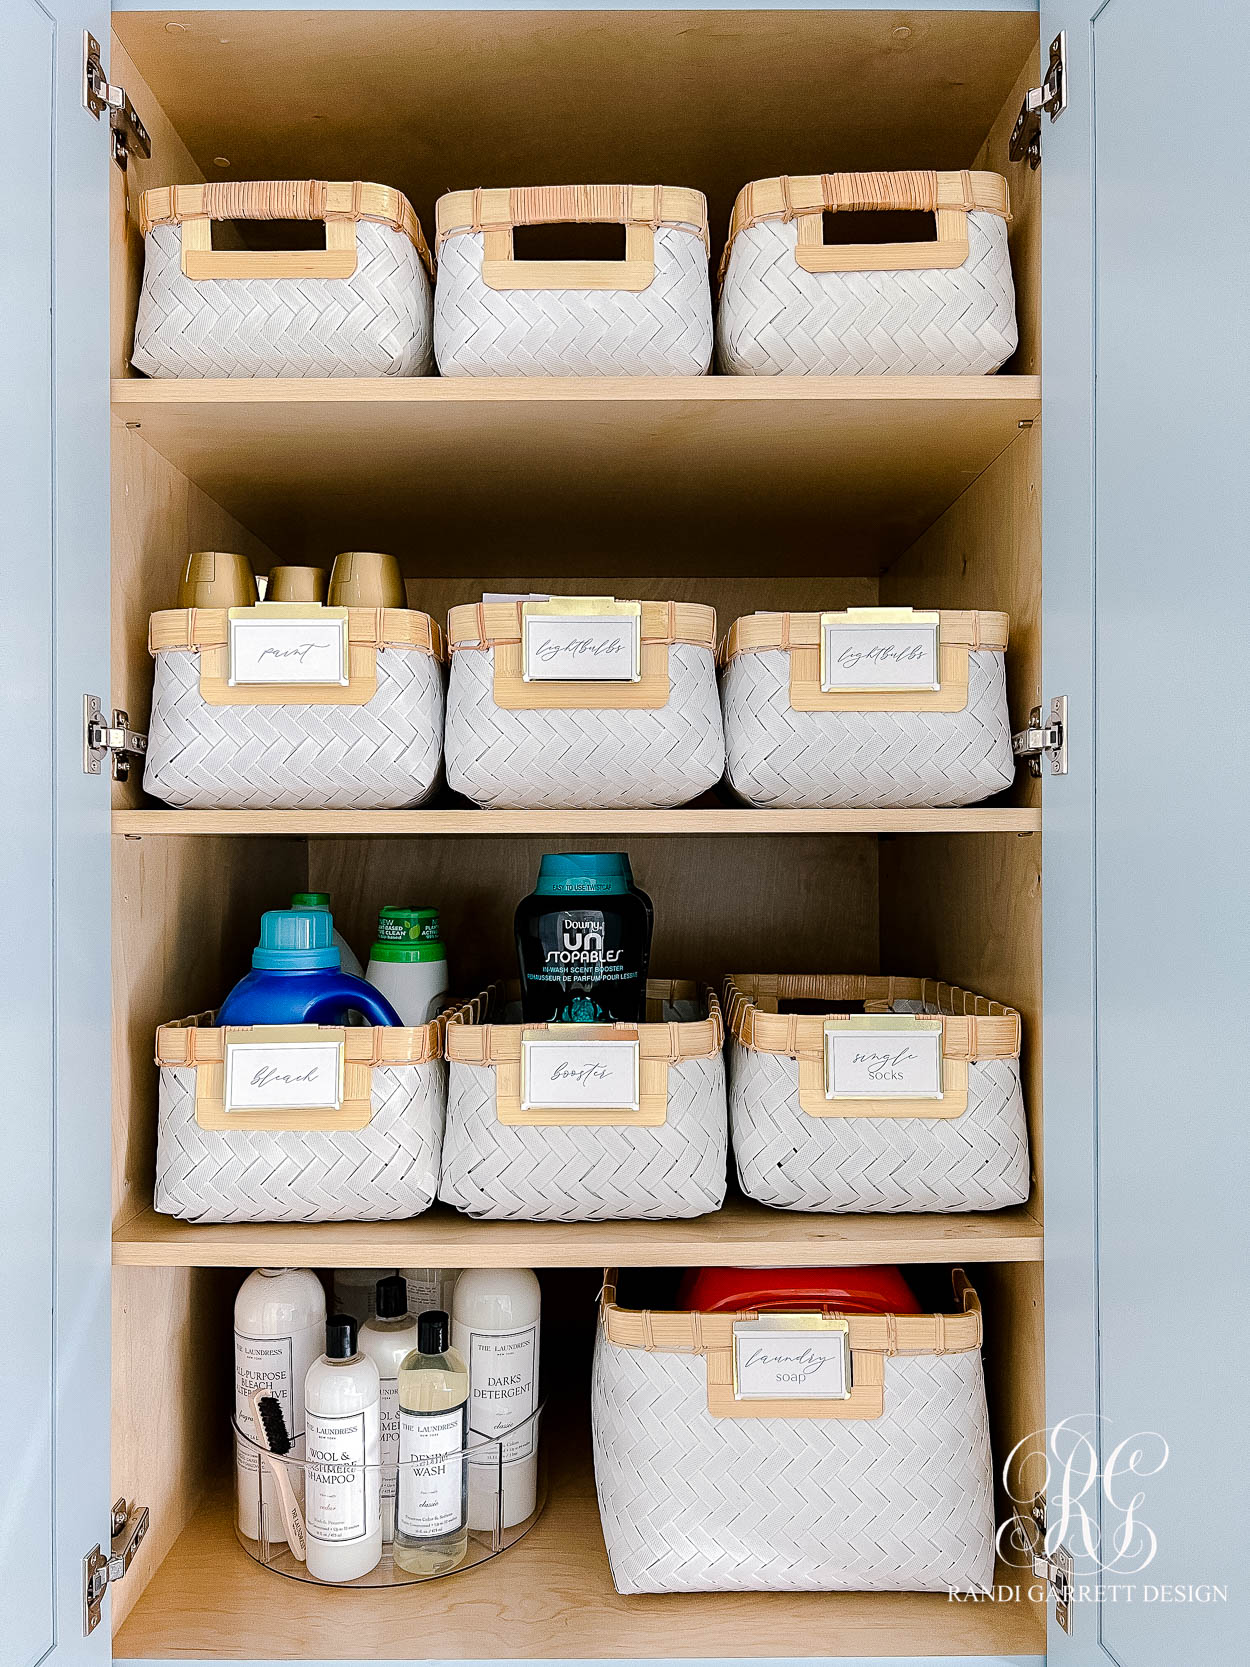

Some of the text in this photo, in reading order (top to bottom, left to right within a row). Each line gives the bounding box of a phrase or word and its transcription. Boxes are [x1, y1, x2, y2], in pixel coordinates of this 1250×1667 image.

[257, 643, 331, 663] paint
[535, 637, 626, 662] lightbulbs
[837, 644, 928, 668] lightbulbs
[564, 919, 600, 931] Downy
[545, 949, 624, 963] STOPABLES
[594, 965, 624, 973] BOOSTER
[852, 1047, 918, 1073] single
[250, 1065, 319, 1088] bleach
[550, 1061, 613, 1087] booster
[868, 1069, 904, 1081] socks
[244, 1347, 283, 1356] LAUNDRESS
[478, 1340, 531, 1352] THE LAUNDRESS
[745, 1348, 836, 1375] laundry
[241, 1377, 273, 1390] BLEACH
[488, 1373, 522, 1387] DARKS
[775, 1373, 807, 1384] soap
[473, 1381, 532, 1400] DETERGENT
[316, 1426, 358, 1435] LAUNDRESS
[402, 1423, 414, 1432] THE
[417, 1420, 459, 1433] LAUNDRESS
[309, 1447, 350, 1462] WOOL &
[413, 1464, 446, 1477] WASH
